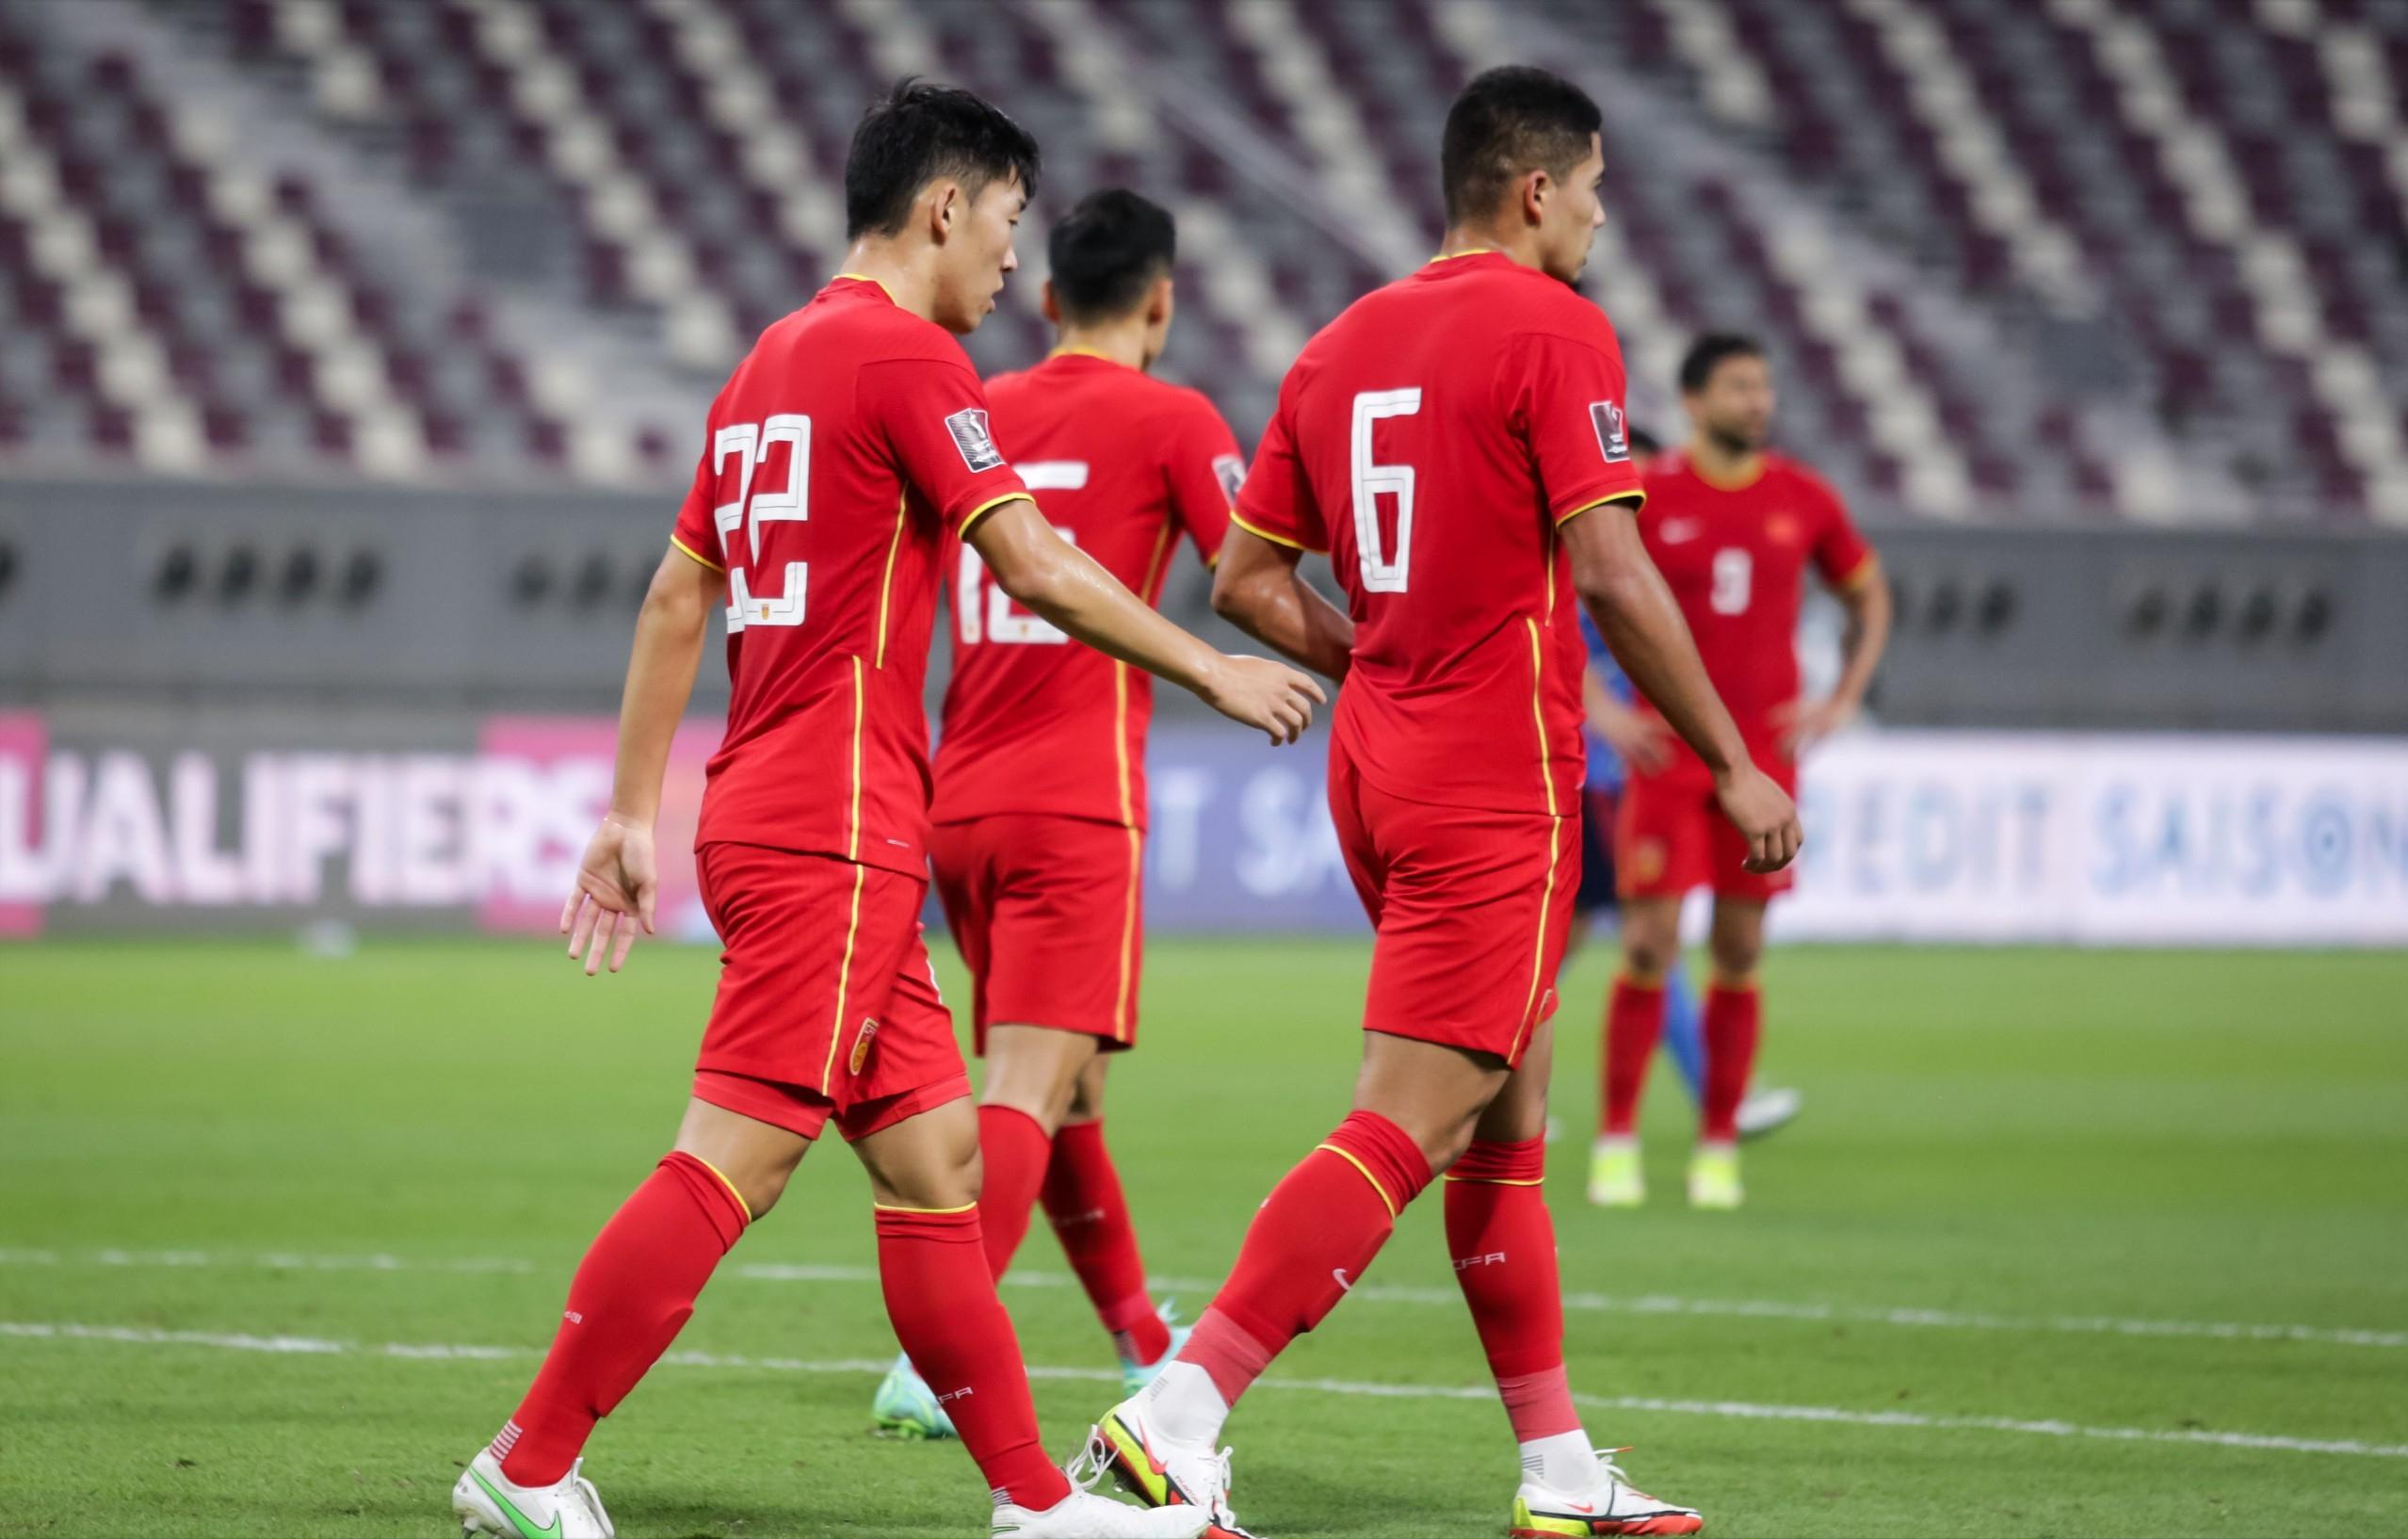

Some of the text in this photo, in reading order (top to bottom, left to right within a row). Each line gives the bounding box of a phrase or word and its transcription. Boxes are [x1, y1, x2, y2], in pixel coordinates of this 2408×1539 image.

[714, 413, 811, 634] 22
[1350, 387, 1422, 593] 6
[1710, 547, 1753, 616] 9
